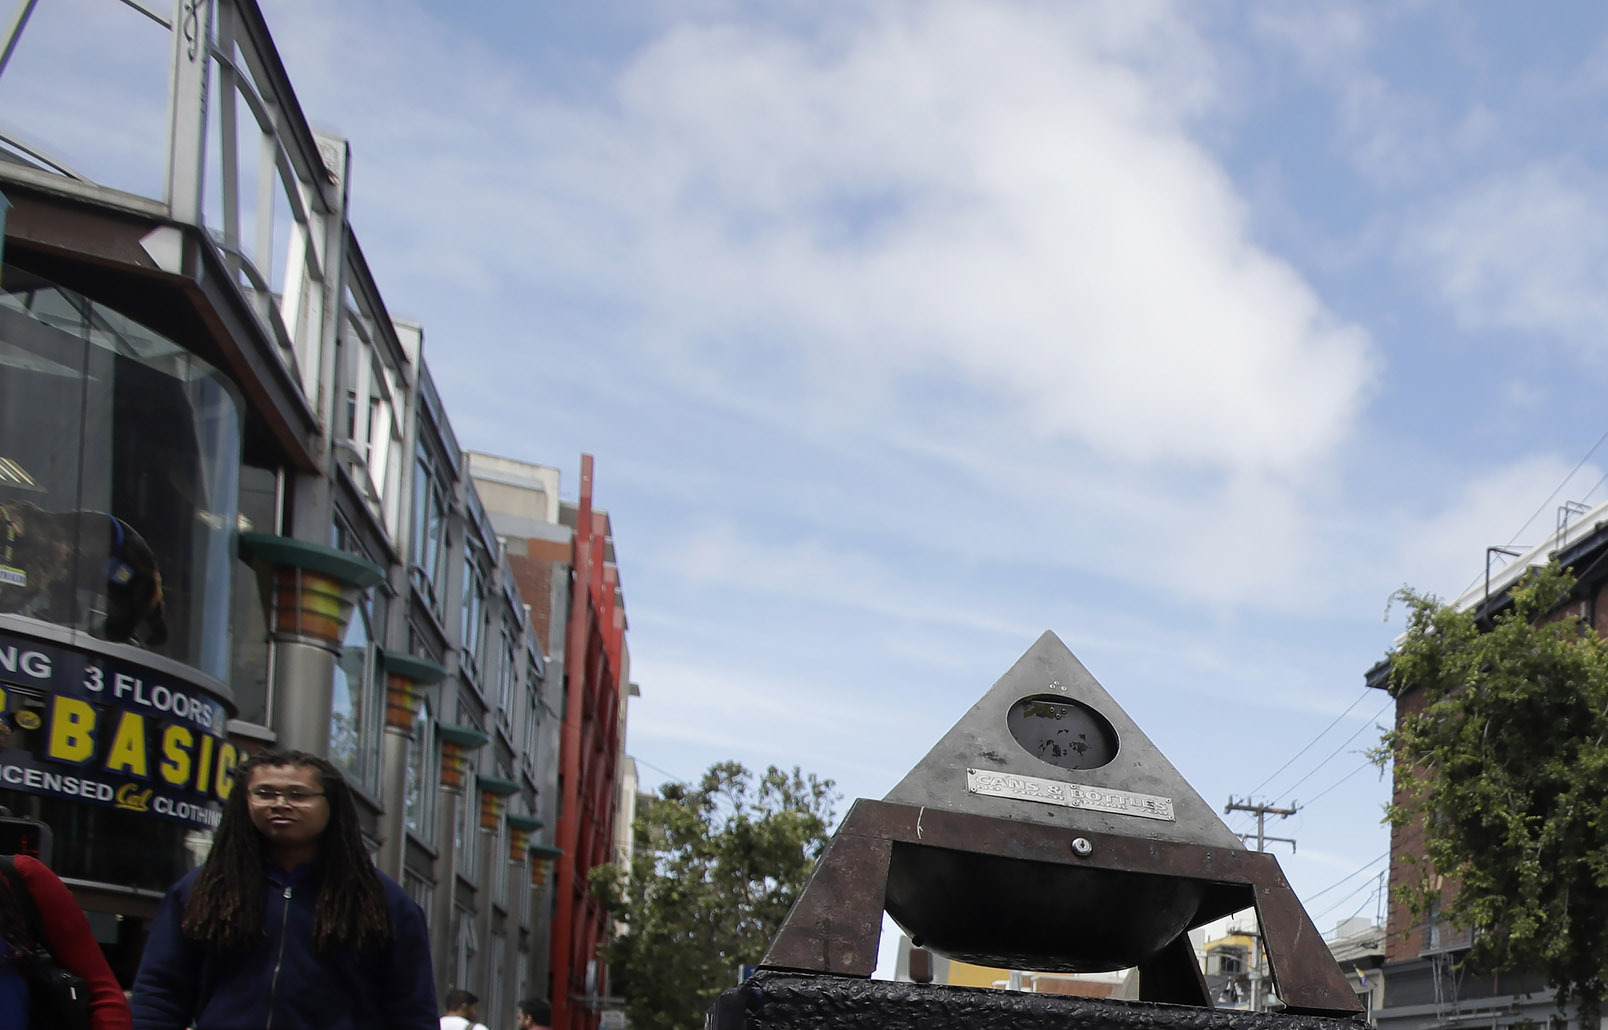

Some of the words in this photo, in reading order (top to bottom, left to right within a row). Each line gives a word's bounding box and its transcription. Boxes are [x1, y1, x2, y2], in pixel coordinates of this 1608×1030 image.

[84, 667, 104, 692] 3
[115, 674, 213, 728] FLOORS
[48, 695, 249, 800] BASIC
[976, 775, 1040, 791] CANS
[1047, 785, 1063, 795] &
[1070, 789, 1167, 810] BOTTLES
